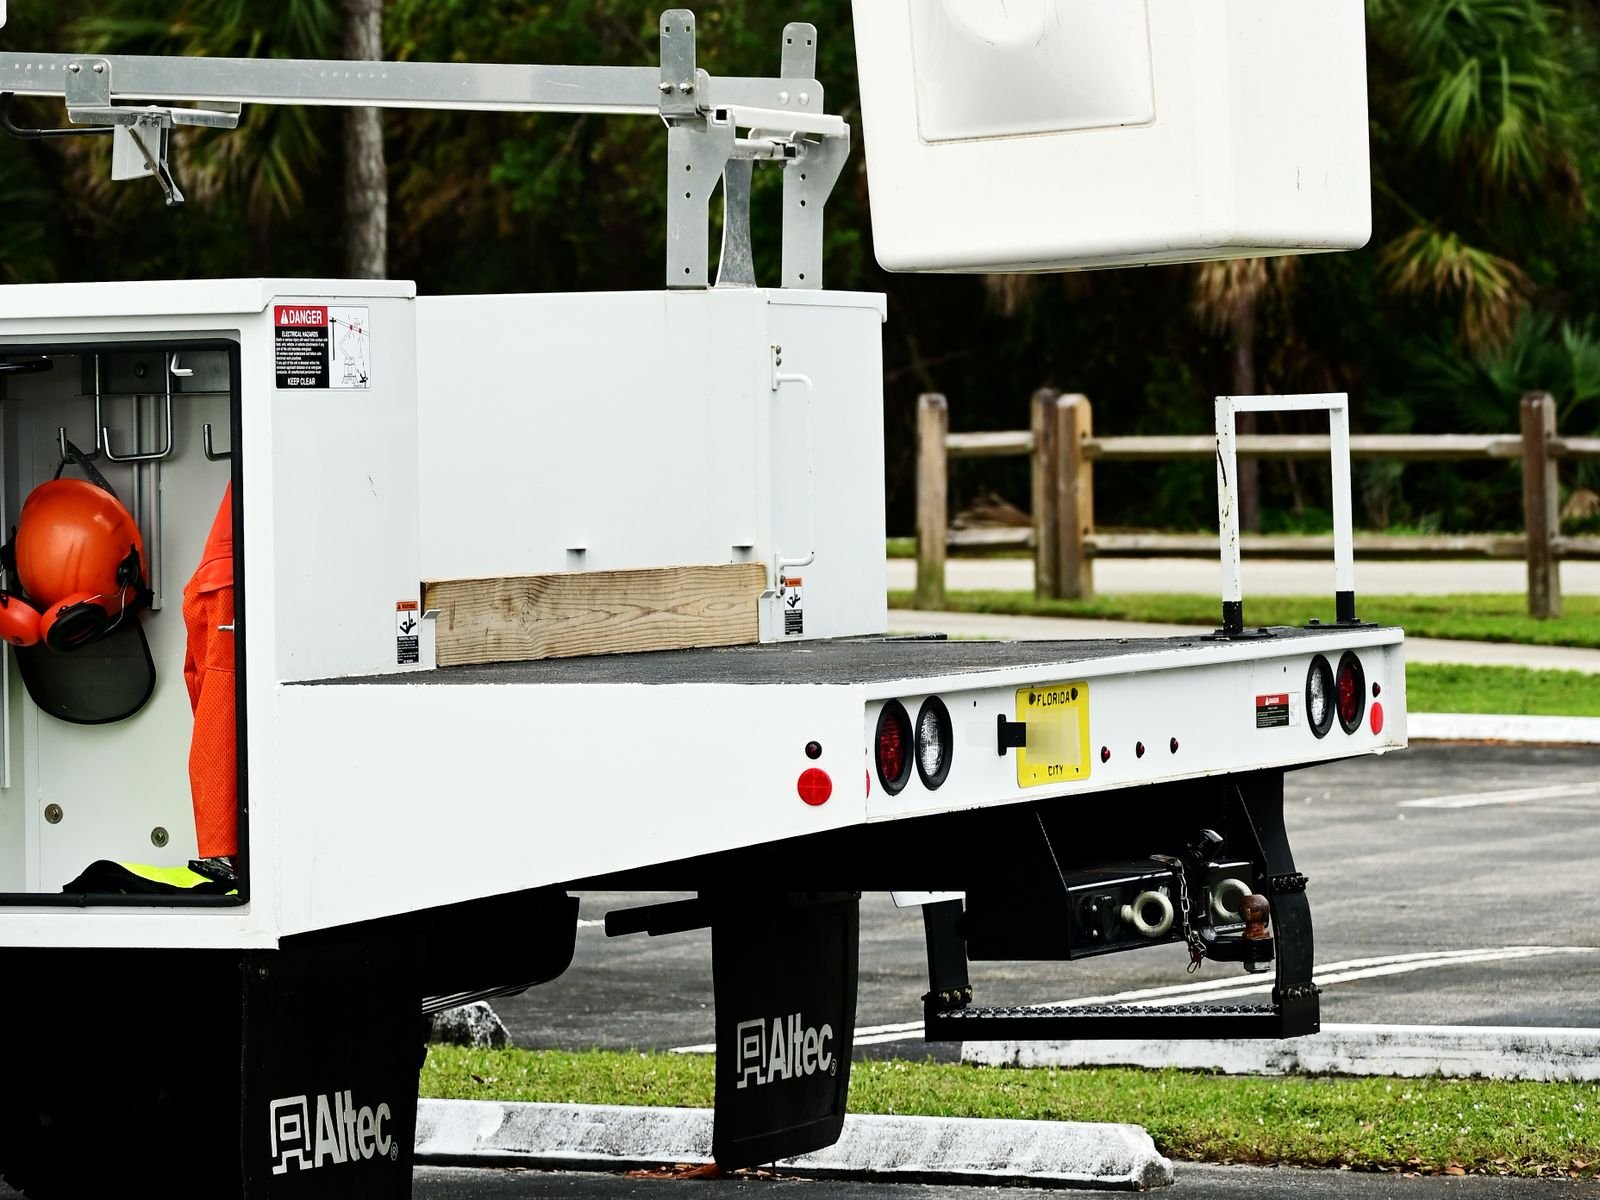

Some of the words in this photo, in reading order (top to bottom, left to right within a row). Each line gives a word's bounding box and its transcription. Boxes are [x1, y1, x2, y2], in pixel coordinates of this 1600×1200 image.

[289, 309, 323, 325] DANGER
[287, 377, 300, 386] KEEP
[300, 377, 316, 386] CLEAR
[1036, 690, 1070, 707] FLORIDA
[1047, 764, 1064, 777] CITY
[767, 1012, 833, 1083] Altec
[314, 1089, 392, 1168] Altec
